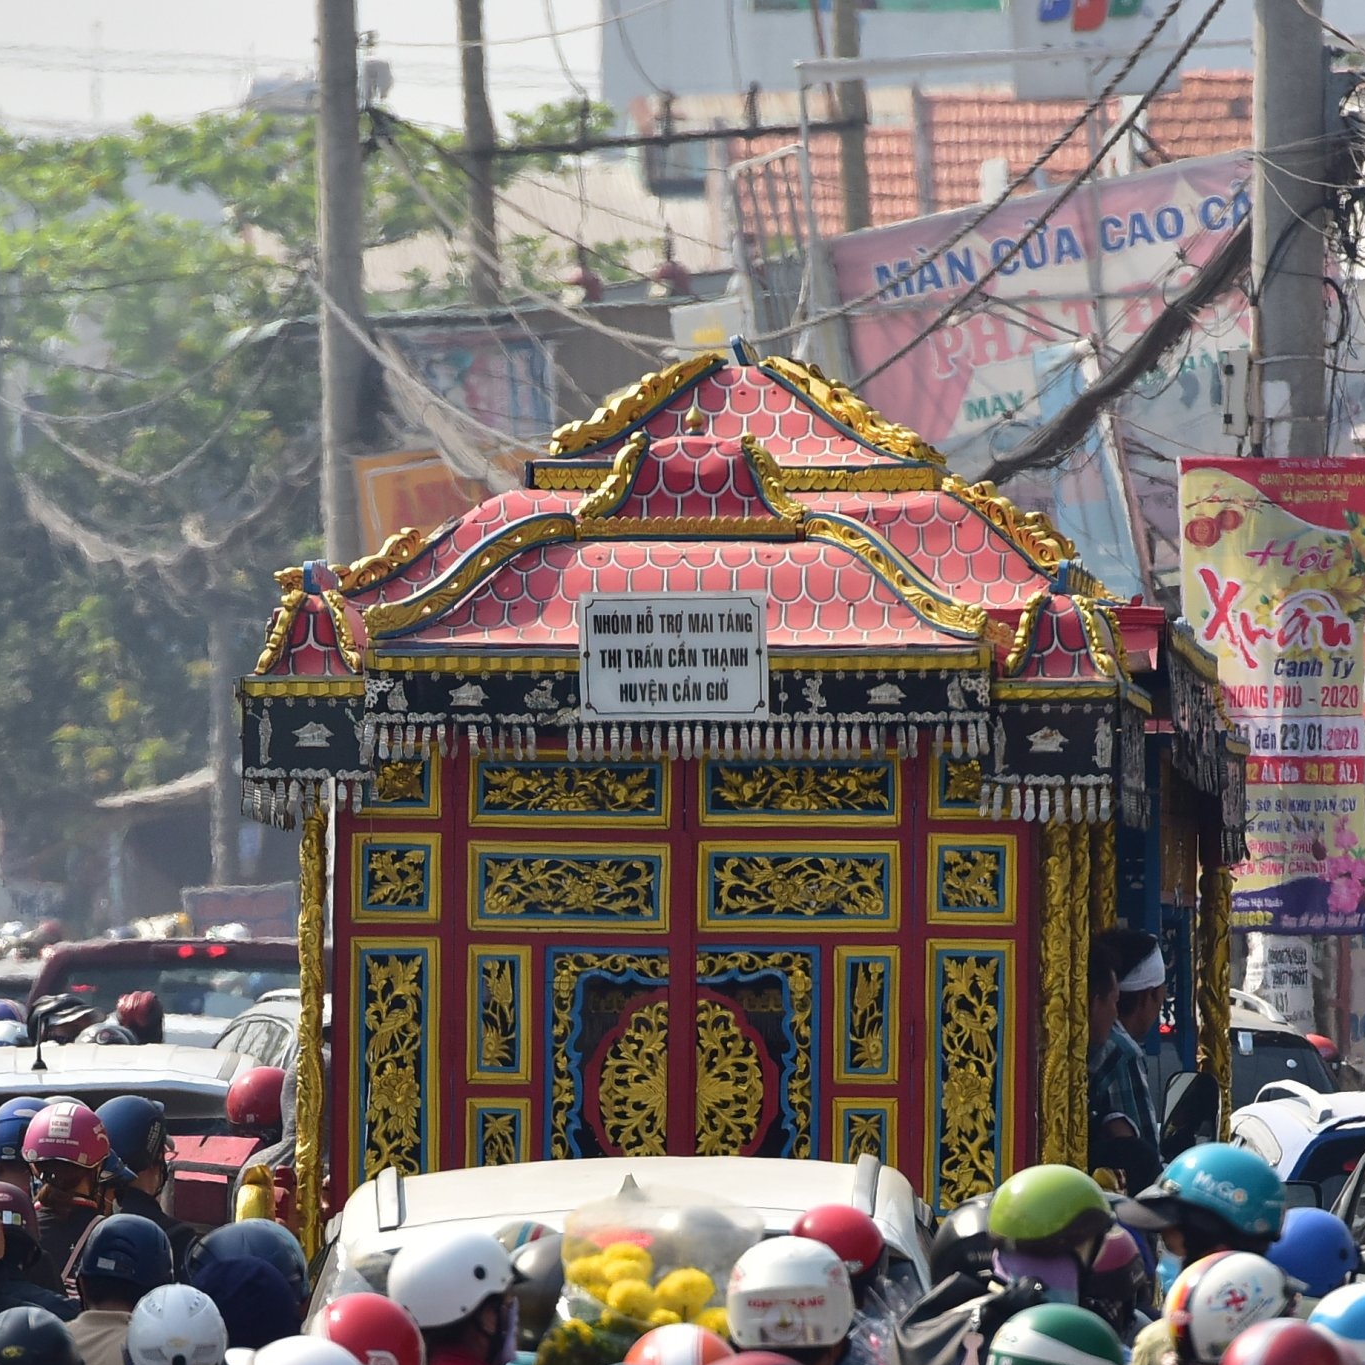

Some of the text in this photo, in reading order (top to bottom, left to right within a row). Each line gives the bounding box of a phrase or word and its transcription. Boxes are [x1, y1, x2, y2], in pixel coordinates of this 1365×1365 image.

[874, 246, 978, 301] MÀN
[1100, 204, 1184, 253] CAO
[1246, 540, 1334, 576] Hội
[593, 606, 753, 639] NHÓM HỖ TRỢ MAI TÁNG
[1198, 567, 1353, 669] Xuân
[599, 649, 622, 673] THỊ
[626, 643, 663, 669] TRẤN
[701, 647, 749, 672] THẠNH
[1273, 657, 1324, 679] Canh
[619, 679, 668, 707] HUYỆN
[706, 678, 729, 702] GIỜ
[1320, 684, 1359, 709] 2020
